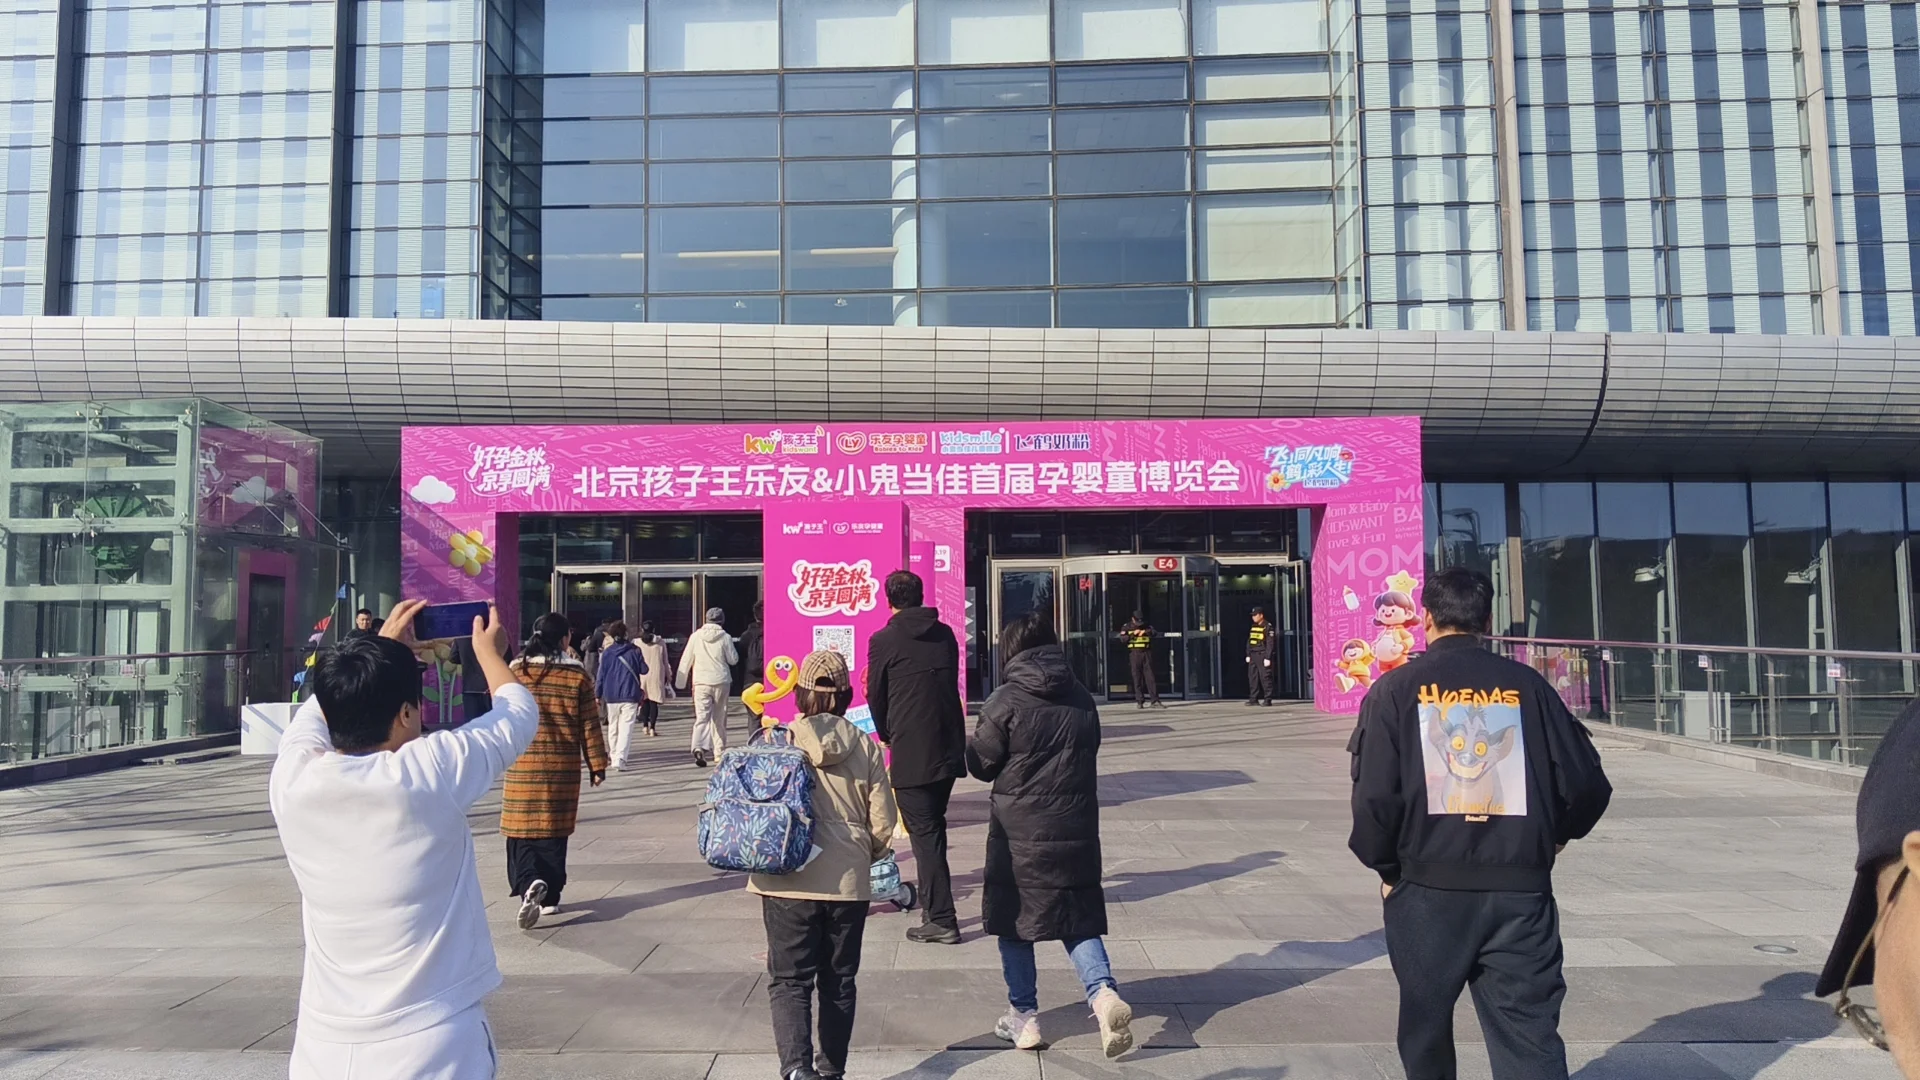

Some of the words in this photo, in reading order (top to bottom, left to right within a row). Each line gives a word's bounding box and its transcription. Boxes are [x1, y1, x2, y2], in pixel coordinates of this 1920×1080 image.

[782, 434, 817, 446] 孩子王
[870, 433, 926, 445] 乐友孕婴童
[1015, 434, 1090, 450] 飞鹤奶粉
[468, 446, 546, 479] 好孕金秋
[477, 465, 551, 495] 京享圆满
[572, 458, 1241, 499] 北京孩子王乐友&小鬼当佳首届孕婴童博览会
[1159, 559, 1174, 569] E4
[796, 566, 867, 597] 好孕金秋
[1080, 577, 1092, 590] E4
[803, 584, 871, 611] 京享圆满
[1418, 683, 1520, 720] HYENAS
